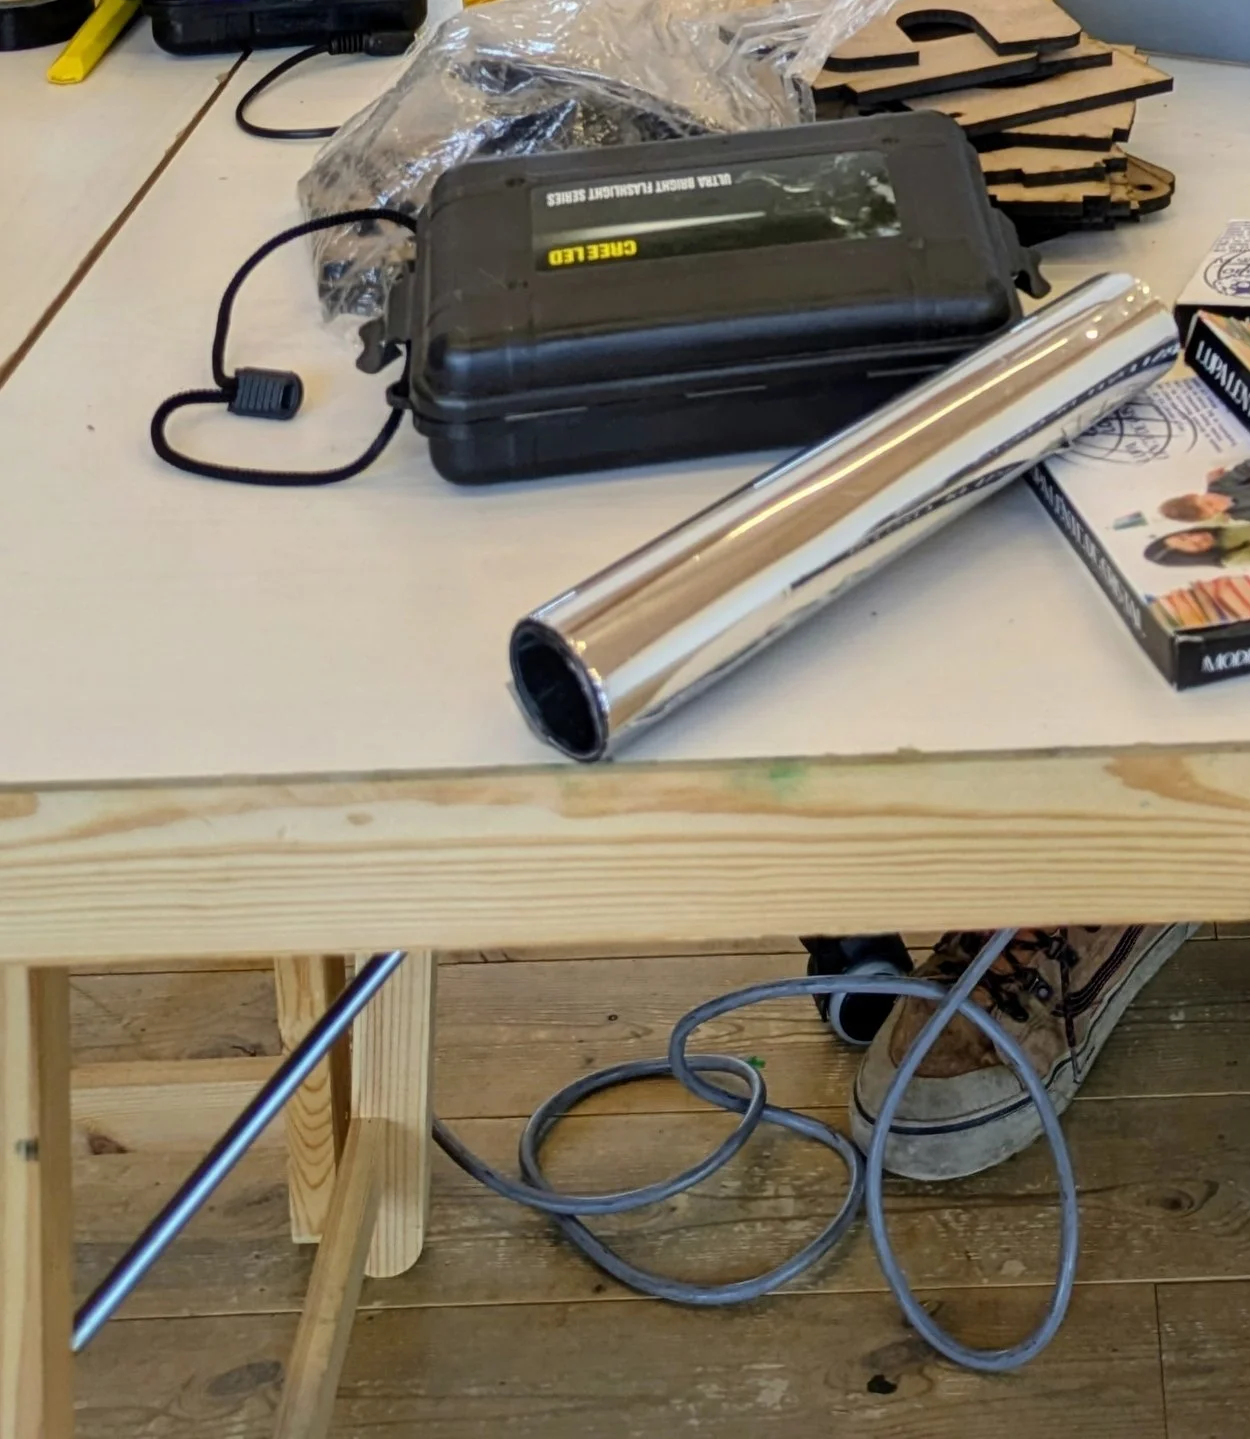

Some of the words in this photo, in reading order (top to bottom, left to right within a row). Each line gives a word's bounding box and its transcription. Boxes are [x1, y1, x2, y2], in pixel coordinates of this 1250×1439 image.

[655, 176, 696, 194] BRIGHT
[696, 172, 733, 189] ULTRA
[546, 188, 586, 207] SERIES
[588, 181, 654, 202] FLASHLIGHT
[548, 246, 585, 266] LED
[588, 239, 638, 261] CREE
[1195, 340, 1228, 387] LUPA
